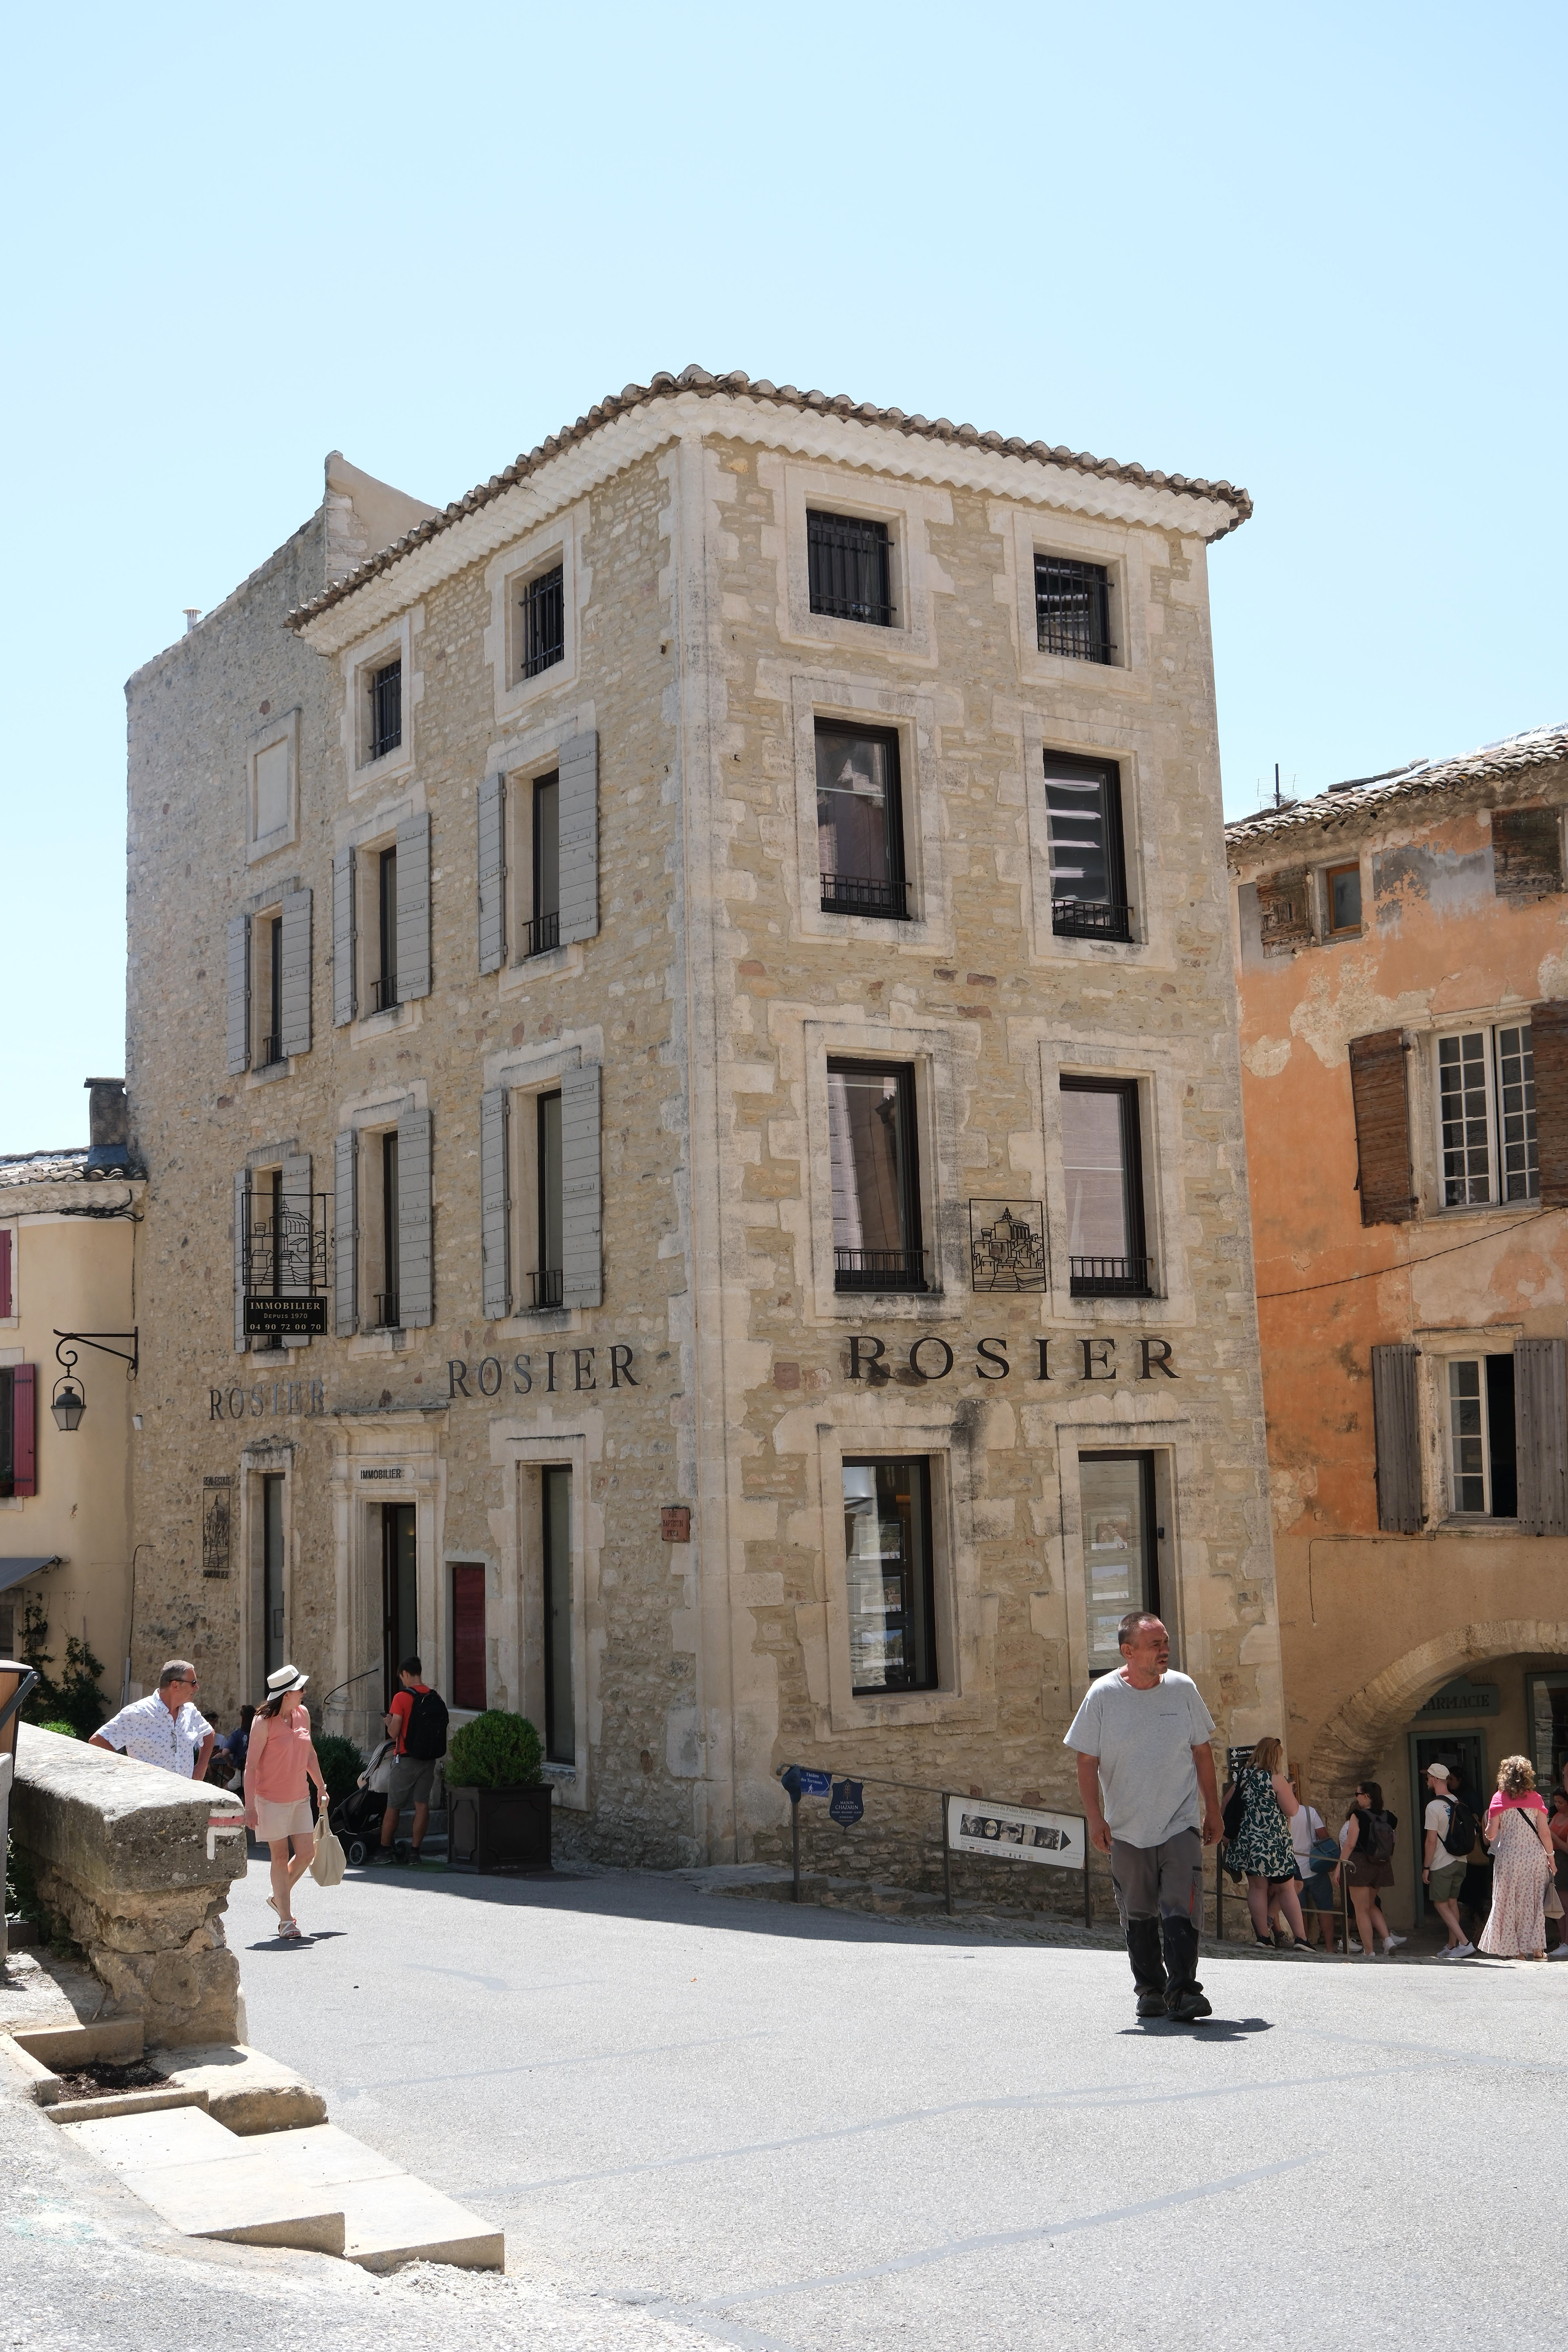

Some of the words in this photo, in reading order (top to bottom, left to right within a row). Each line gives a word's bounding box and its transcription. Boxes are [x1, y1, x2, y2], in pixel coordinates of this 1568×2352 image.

[445, 1345, 641, 1399] ROSIER
[843, 1336, 1182, 1381] ROSIER
[209, 1379, 324, 1421] ROSIER
[361, 1469, 401, 1479] IMMOBILIER
[1421, 1694, 1489, 1710] ARMACIE
